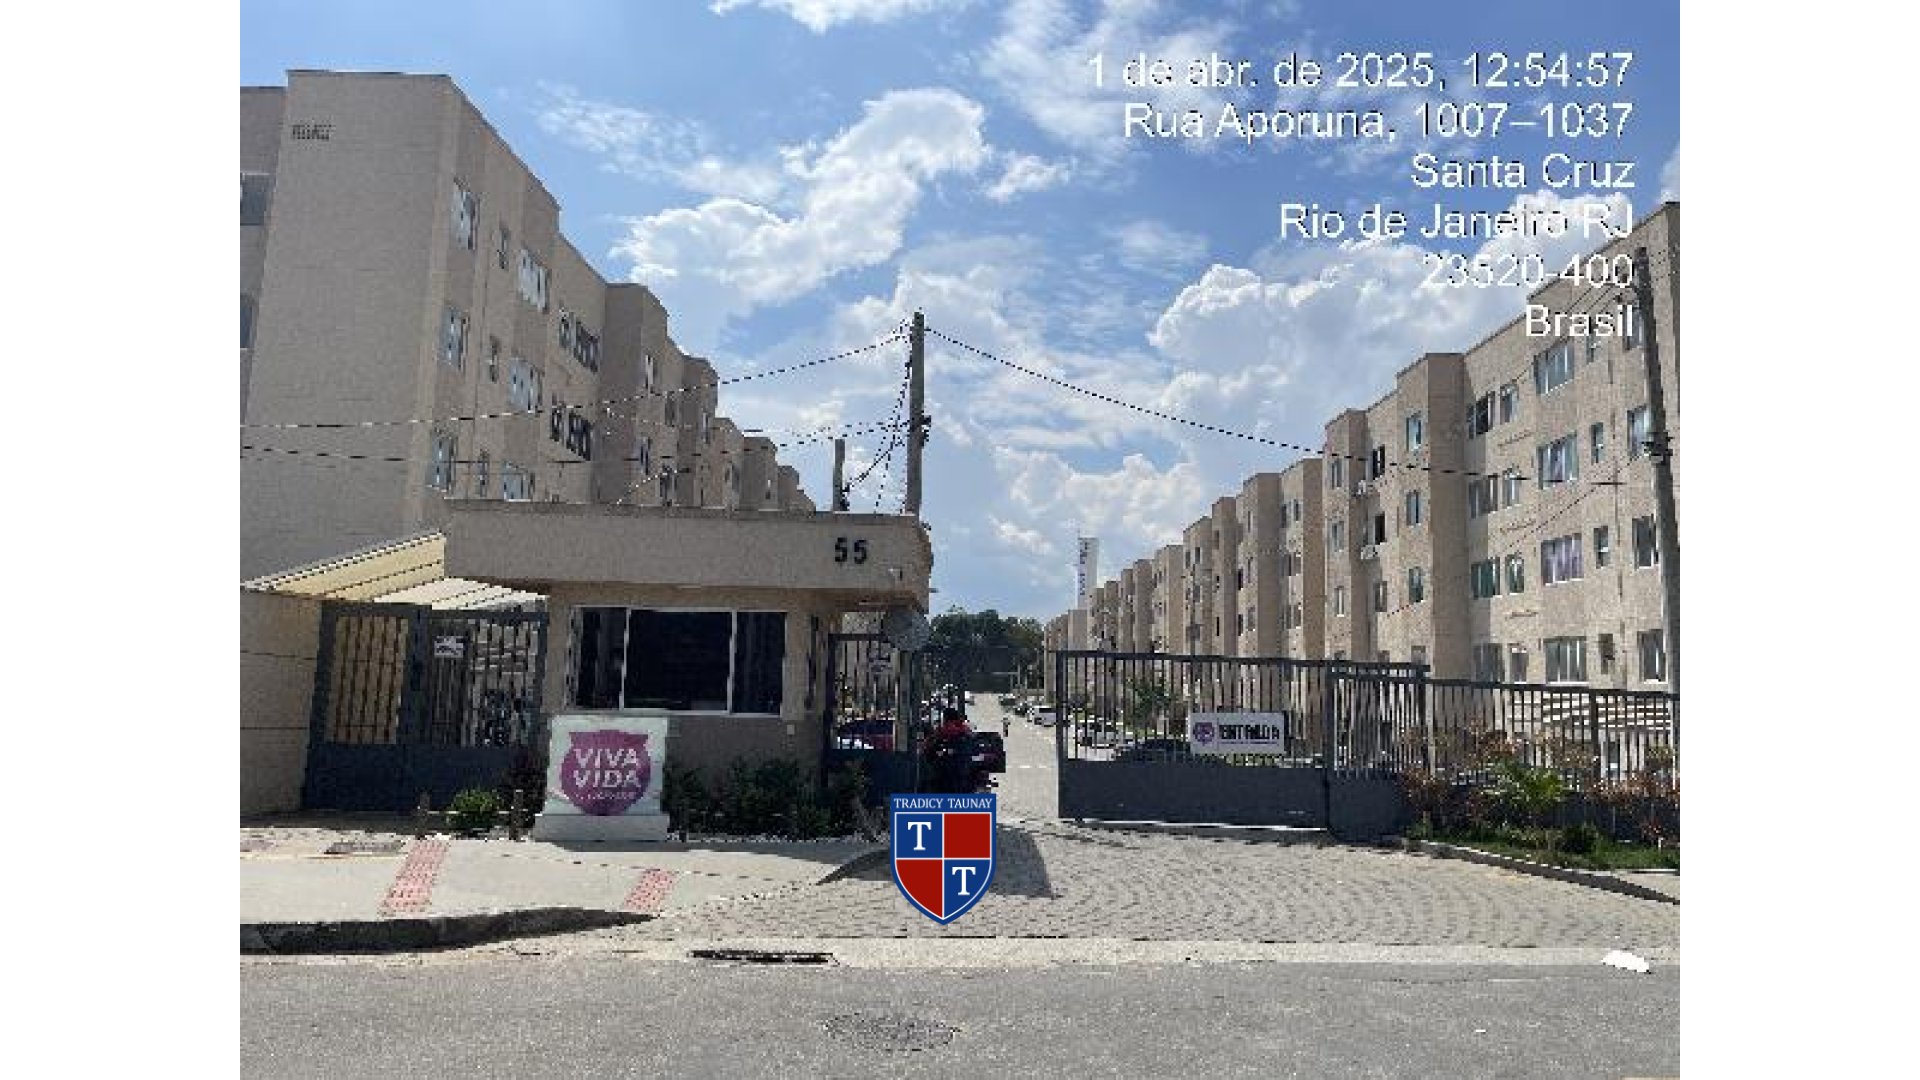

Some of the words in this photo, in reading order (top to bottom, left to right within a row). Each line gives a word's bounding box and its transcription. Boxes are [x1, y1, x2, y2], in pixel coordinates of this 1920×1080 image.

[834, 537, 867, 565] 55
[573, 748, 641, 768] VIVA
[573, 770, 641, 788] VIDA
